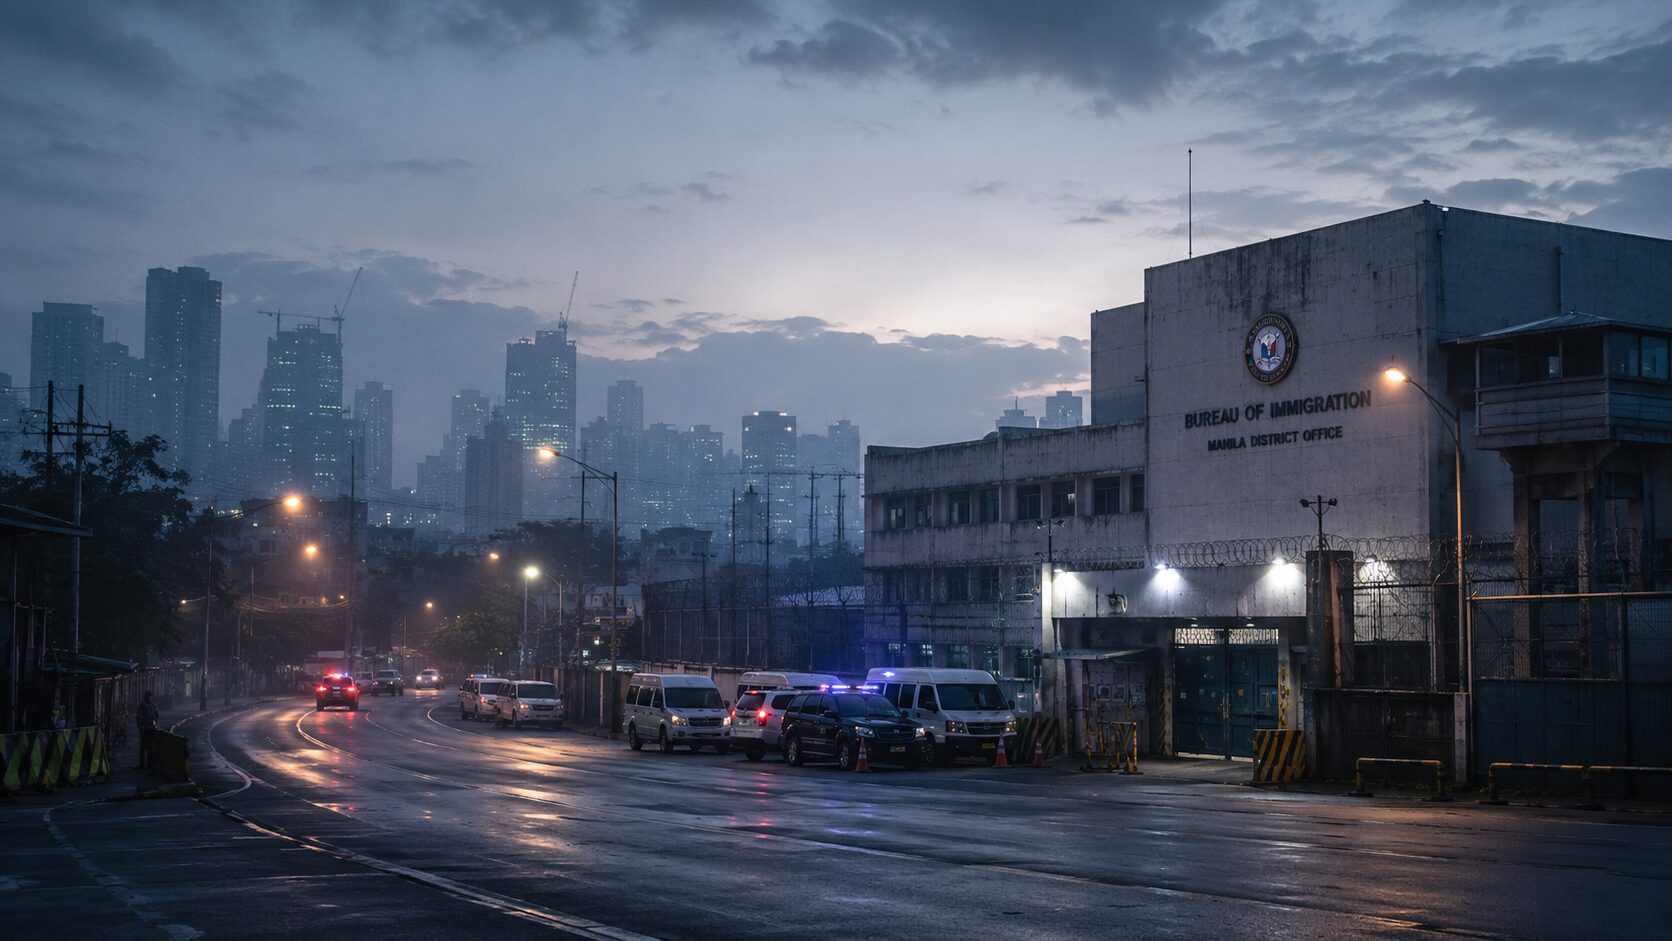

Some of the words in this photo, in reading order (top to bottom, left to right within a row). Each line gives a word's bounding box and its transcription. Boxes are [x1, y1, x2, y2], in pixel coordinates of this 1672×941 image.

[1185, 408, 1239, 429] BUREAU
[1245, 403, 1265, 421] OF
[1270, 390, 1371, 418] IMMIGRATION
[1208, 437, 1246, 451] MANILA
[1250, 431, 1299, 447] DISTRICT
[1303, 426, 1343, 441] OFFICE
